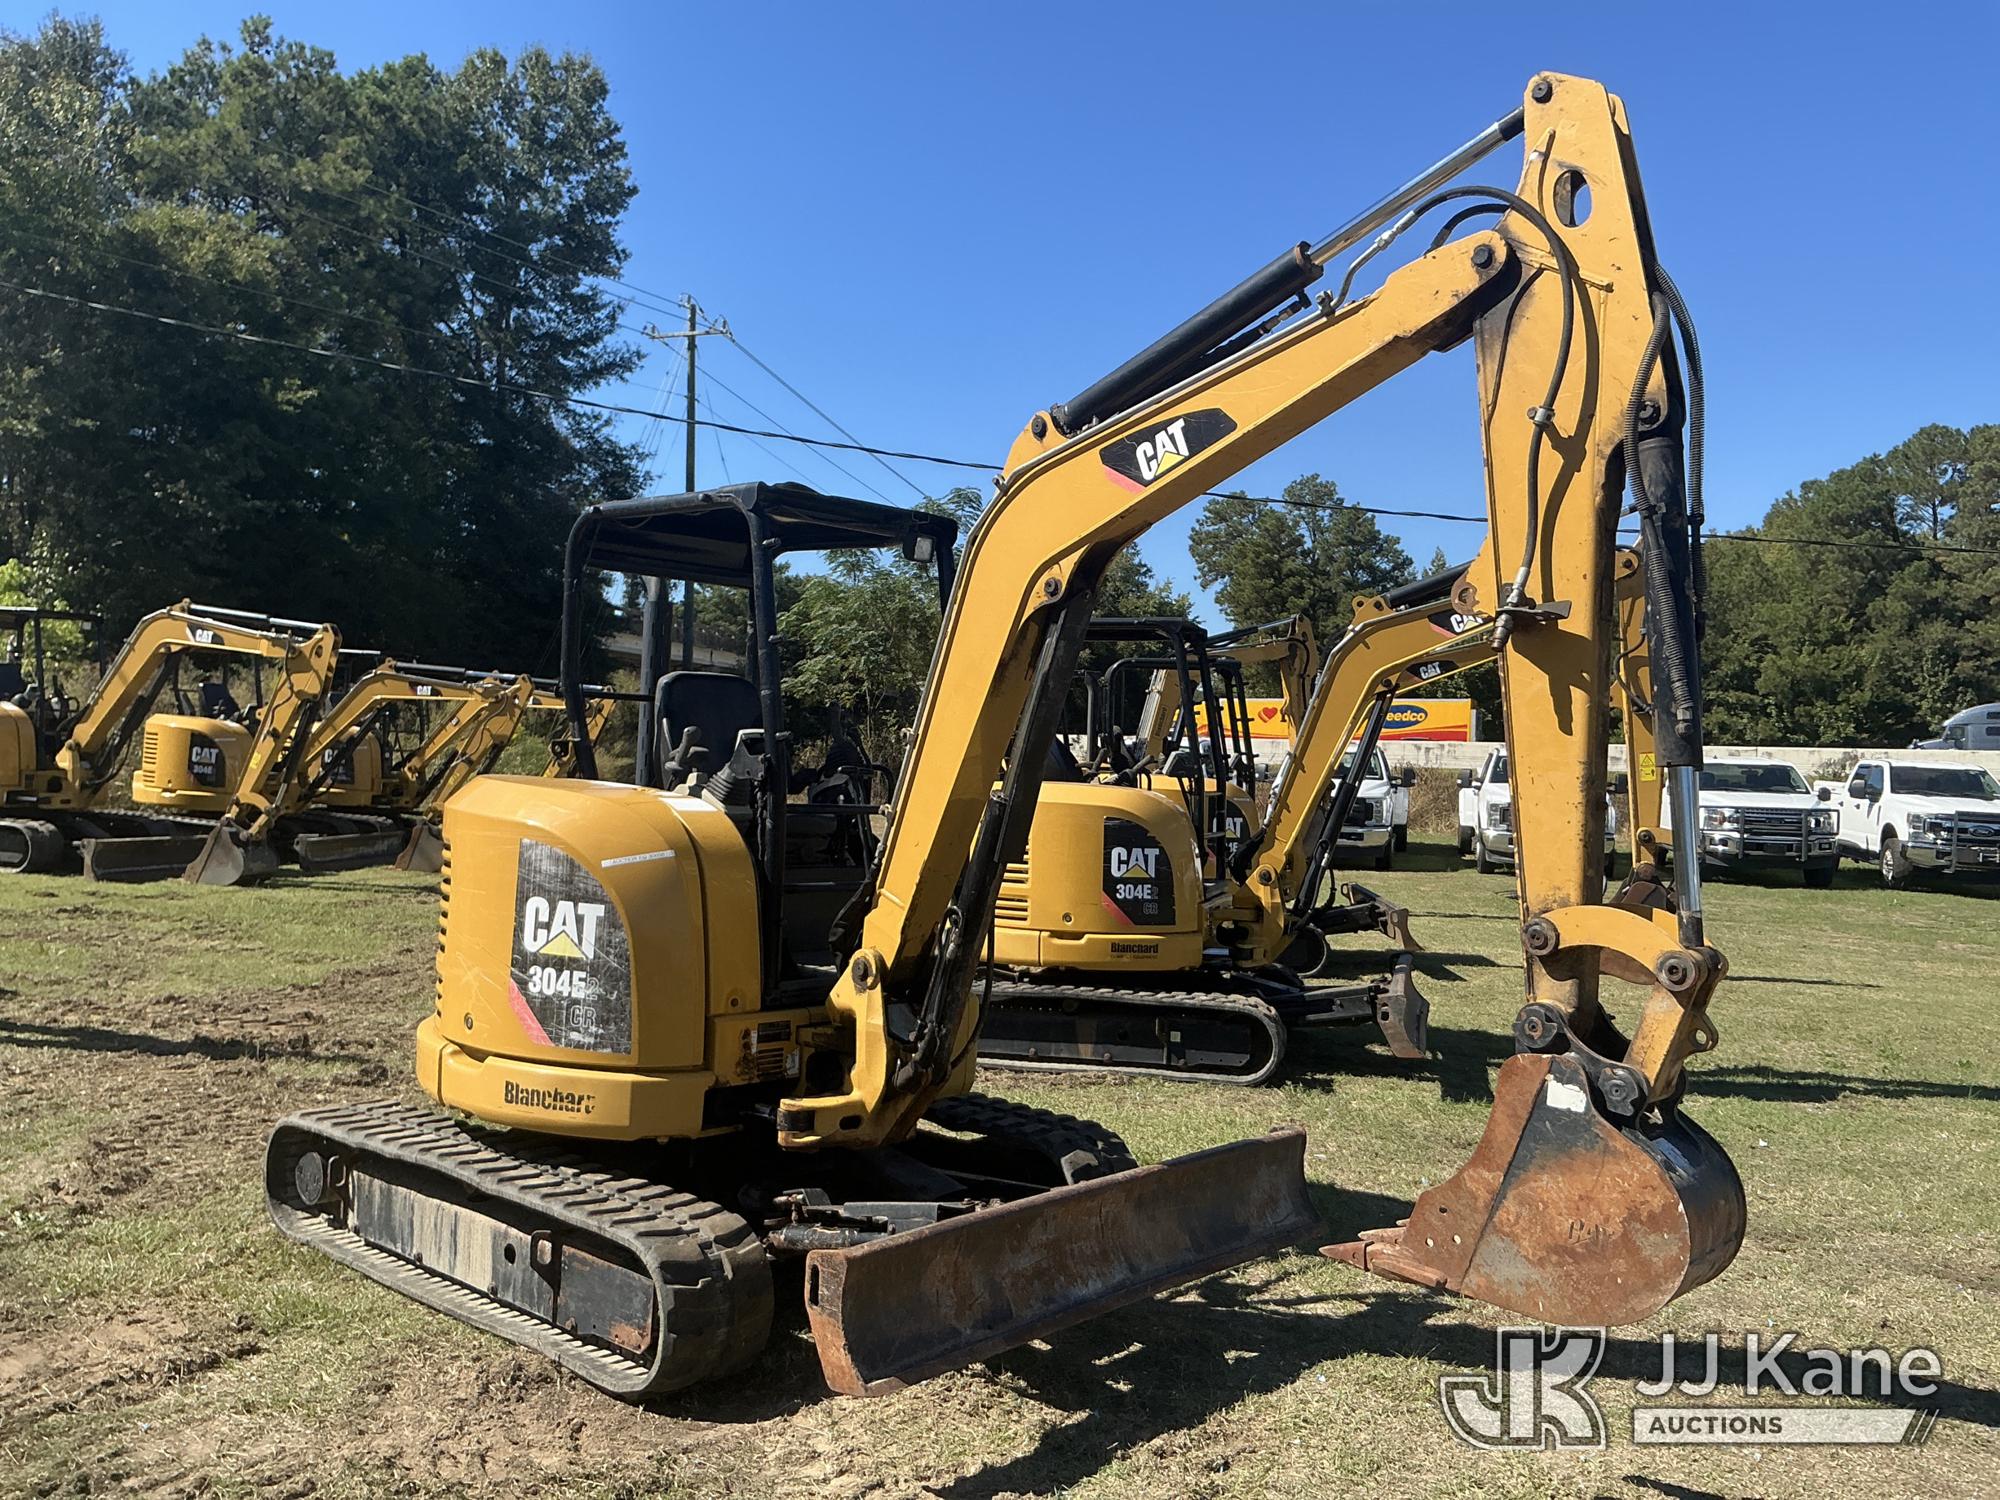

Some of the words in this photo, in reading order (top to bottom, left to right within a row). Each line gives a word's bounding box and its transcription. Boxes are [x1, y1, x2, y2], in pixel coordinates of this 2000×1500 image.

[1135, 418, 1189, 480] CAT
[195, 629, 214, 643] CAT
[1419, 661, 1441, 679] CAT
[416, 685, 432, 696] CAT
[1386, 710, 1425, 721] eedco
[191, 746, 219, 764] CAT
[1110, 847, 1159, 878] CAT
[524, 896, 604, 959] CAT
[1110, 942, 1159, 954] Blanchard
[570, 1004, 596, 1033] CR
